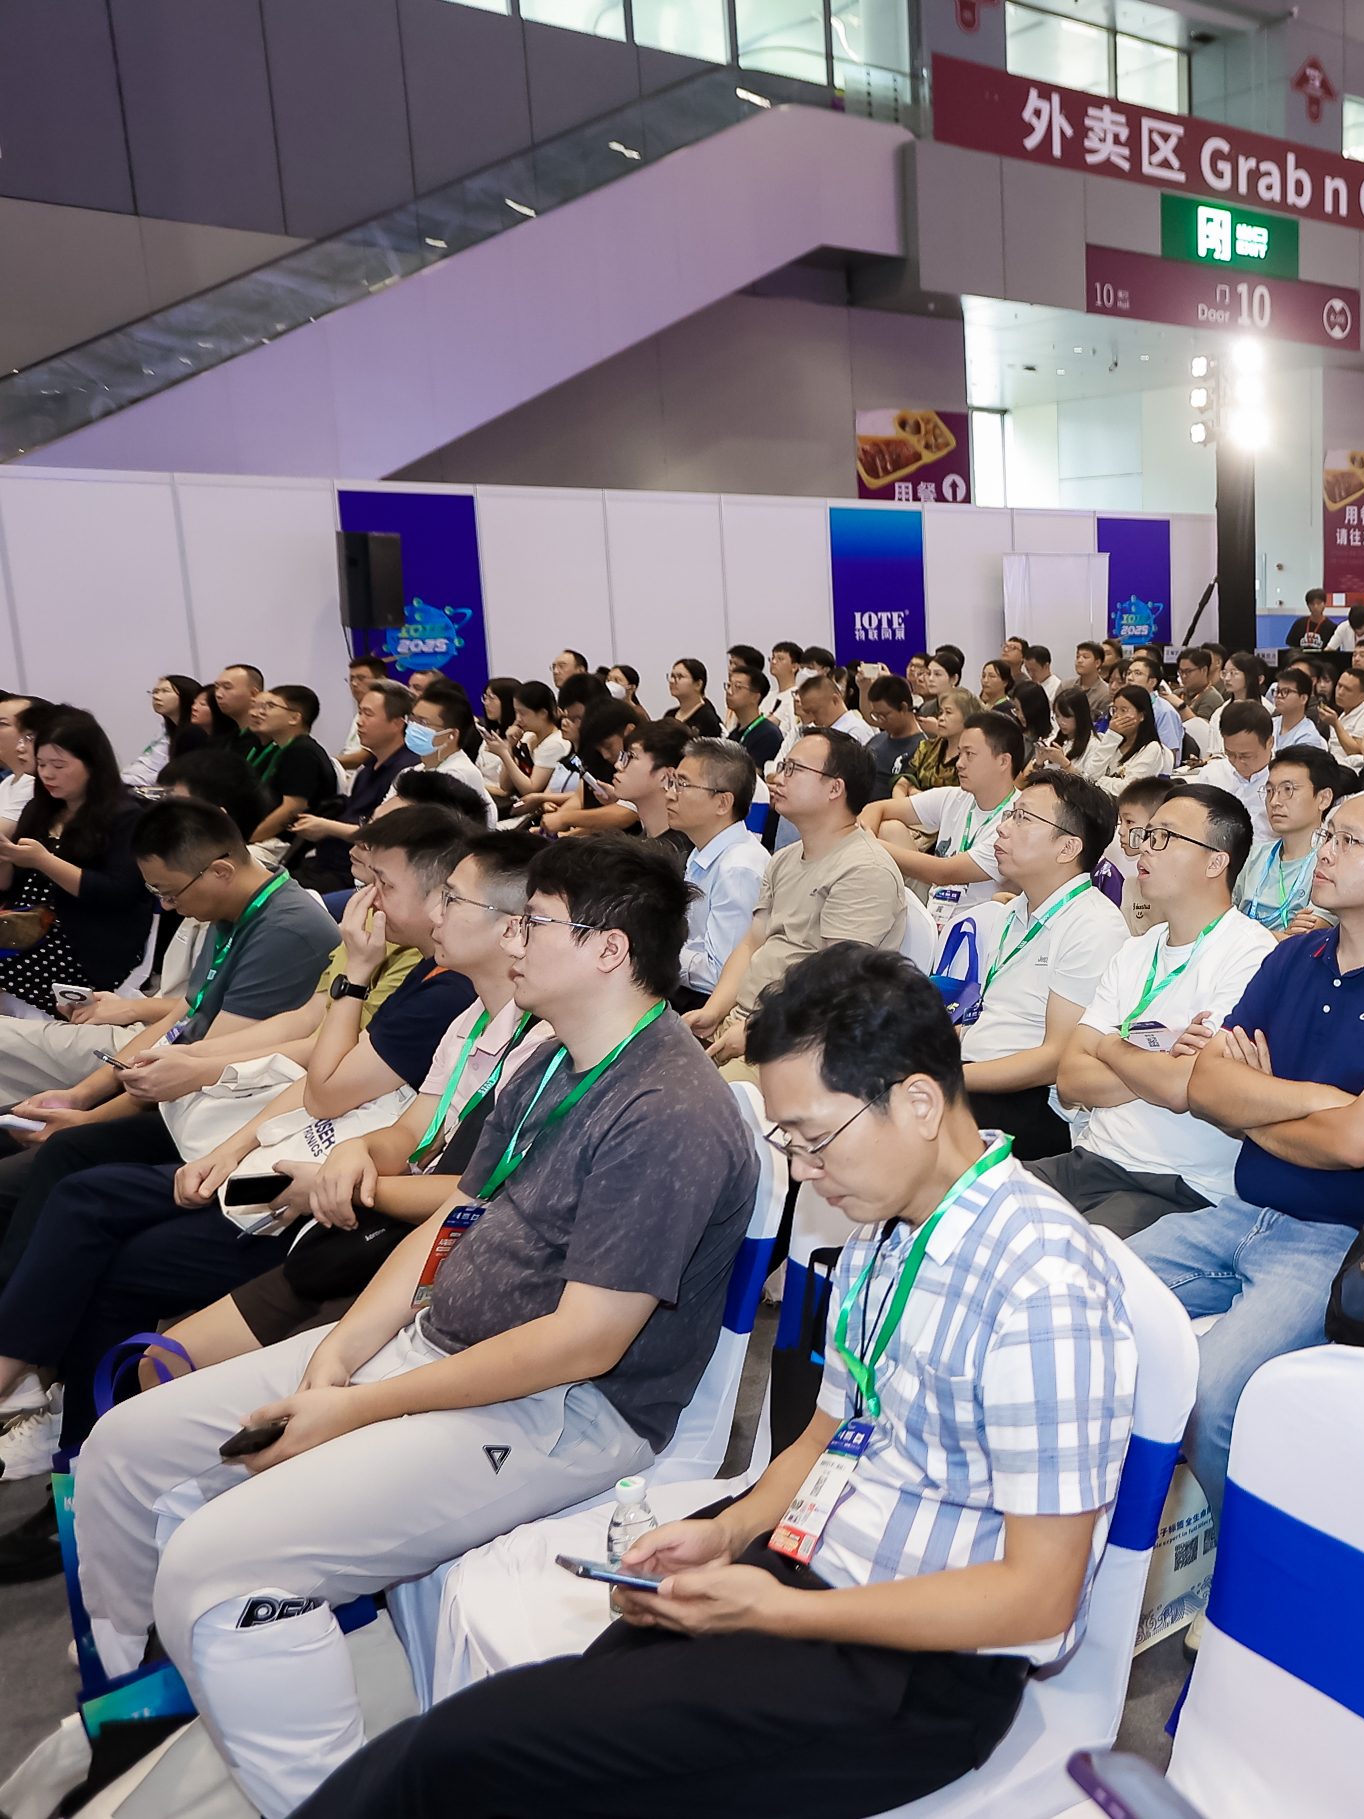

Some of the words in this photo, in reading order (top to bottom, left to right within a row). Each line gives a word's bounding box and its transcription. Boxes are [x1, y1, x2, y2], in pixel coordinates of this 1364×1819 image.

[1021, 87, 1187, 184] 外卖区
[1200, 136, 1312, 209] Grab
[1323, 174, 1348, 218] n
[1095, 282, 1114, 308] 10
[1216, 284, 1230, 304] 门
[1198, 303, 1230, 322] Door
[1237, 282, 1271, 328] 10
[894, 481, 937, 502] 用餐
[854, 610, 905, 629] IOTE
[1120, 624, 1149, 636] 2025
[397, 638, 449, 653] 2025
